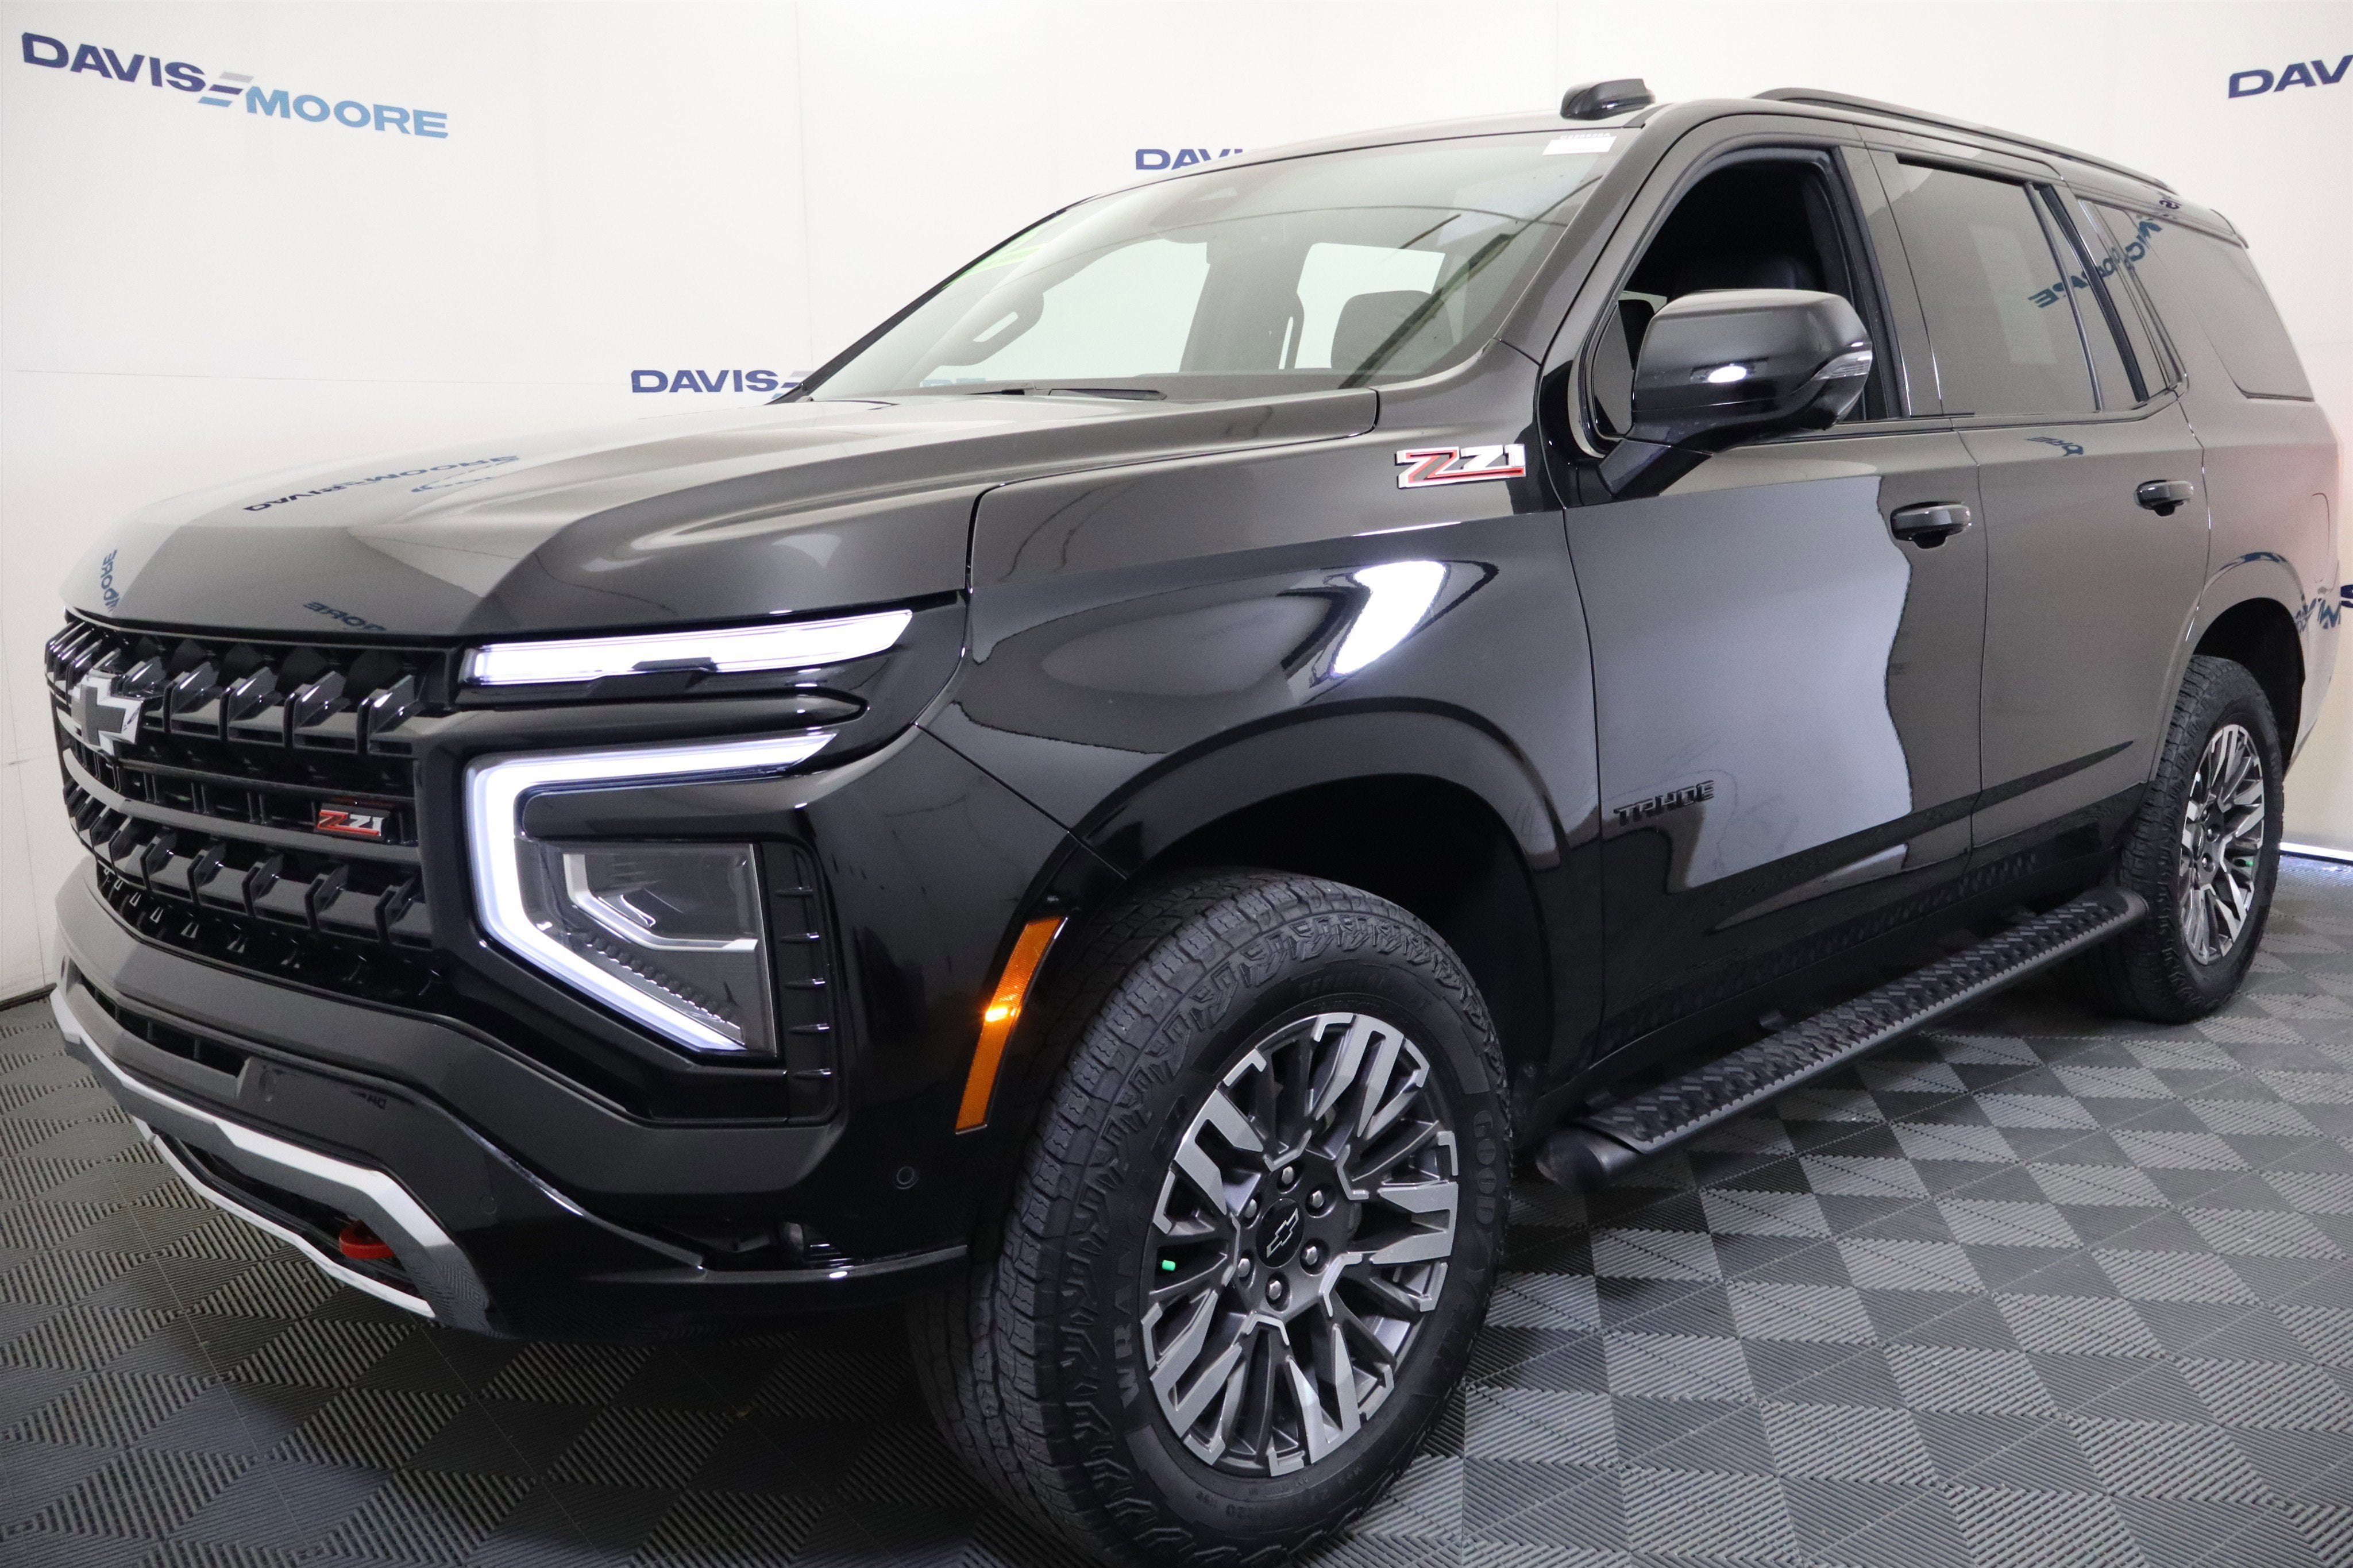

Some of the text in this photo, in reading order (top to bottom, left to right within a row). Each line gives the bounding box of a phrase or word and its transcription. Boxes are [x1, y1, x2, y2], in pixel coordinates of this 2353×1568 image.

[21, 32, 449, 138] DAVIS MOORE
[1135, 148, 1243, 170] DAV
[631, 369, 778, 393] DAVIS
